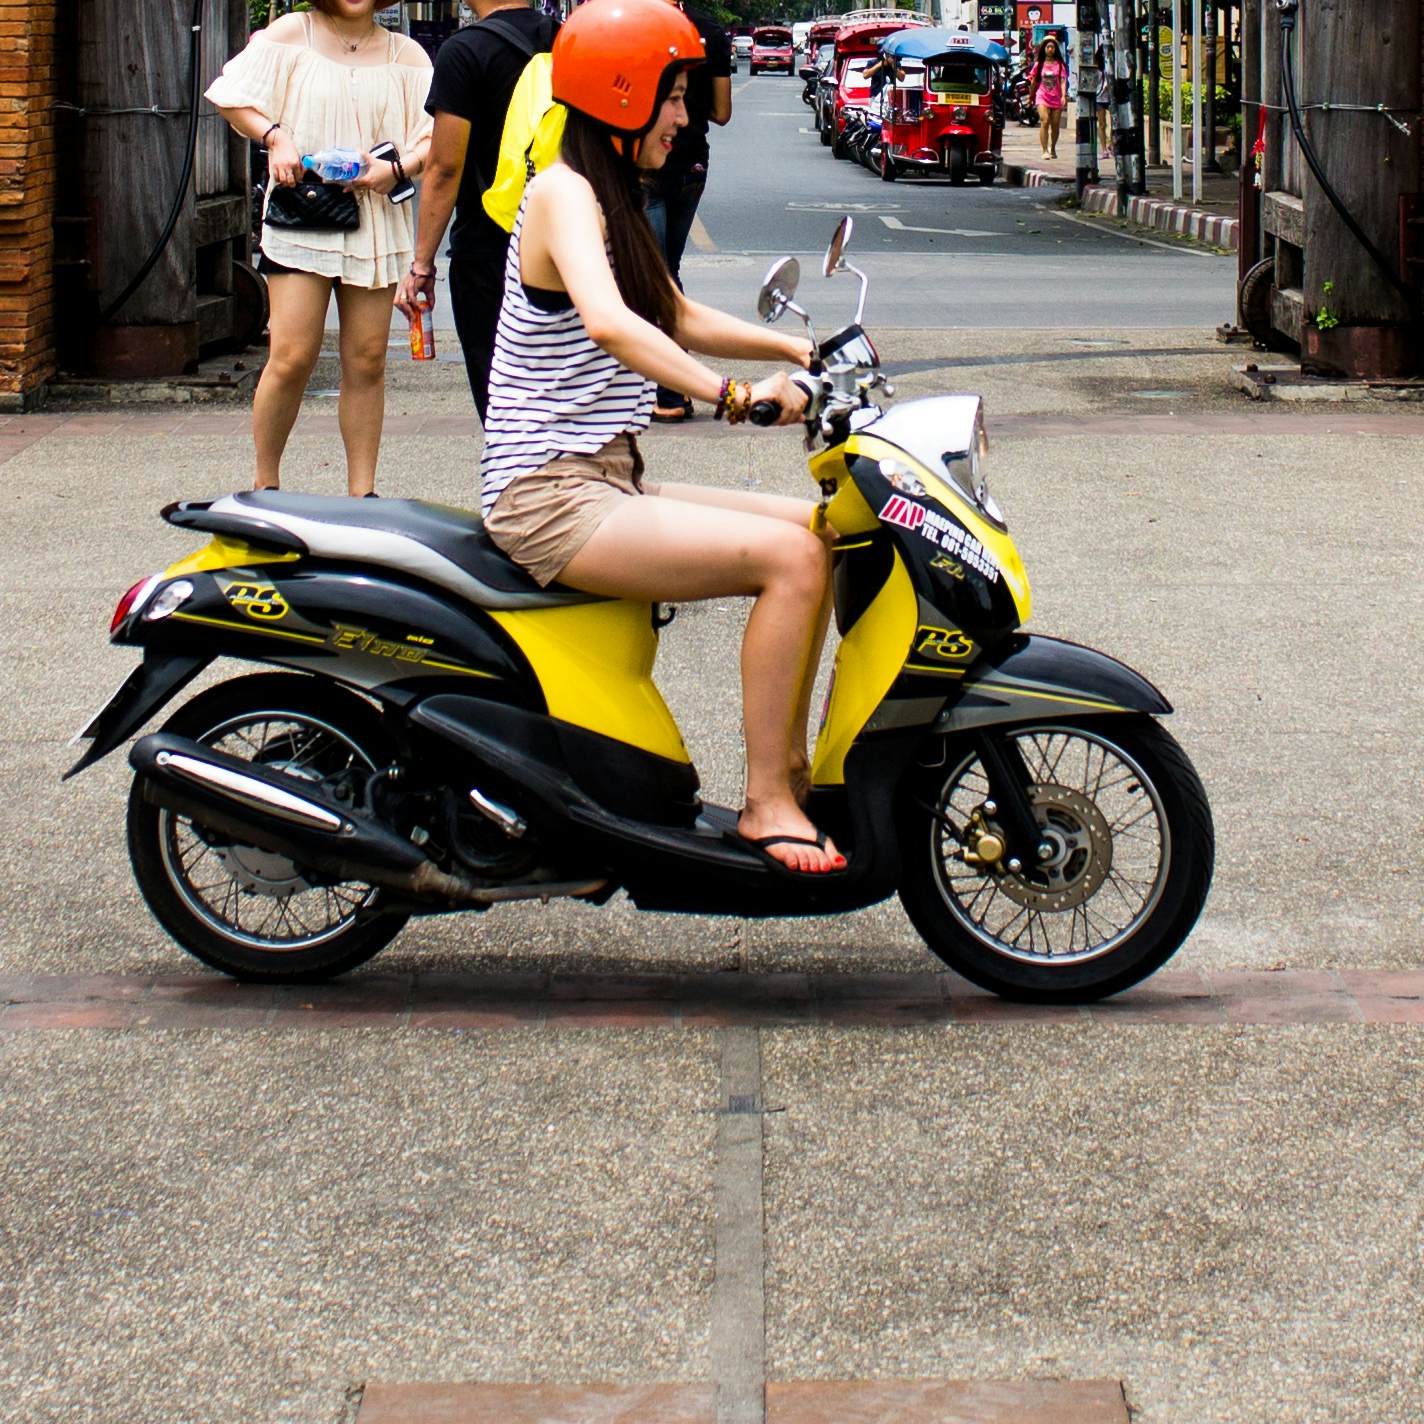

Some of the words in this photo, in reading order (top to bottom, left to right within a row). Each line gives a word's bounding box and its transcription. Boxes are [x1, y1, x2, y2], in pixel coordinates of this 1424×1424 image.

[921, 522, 939, 545] TEL.
[963, 533, 983, 558] CAR
[917, 624, 974, 658] PS
